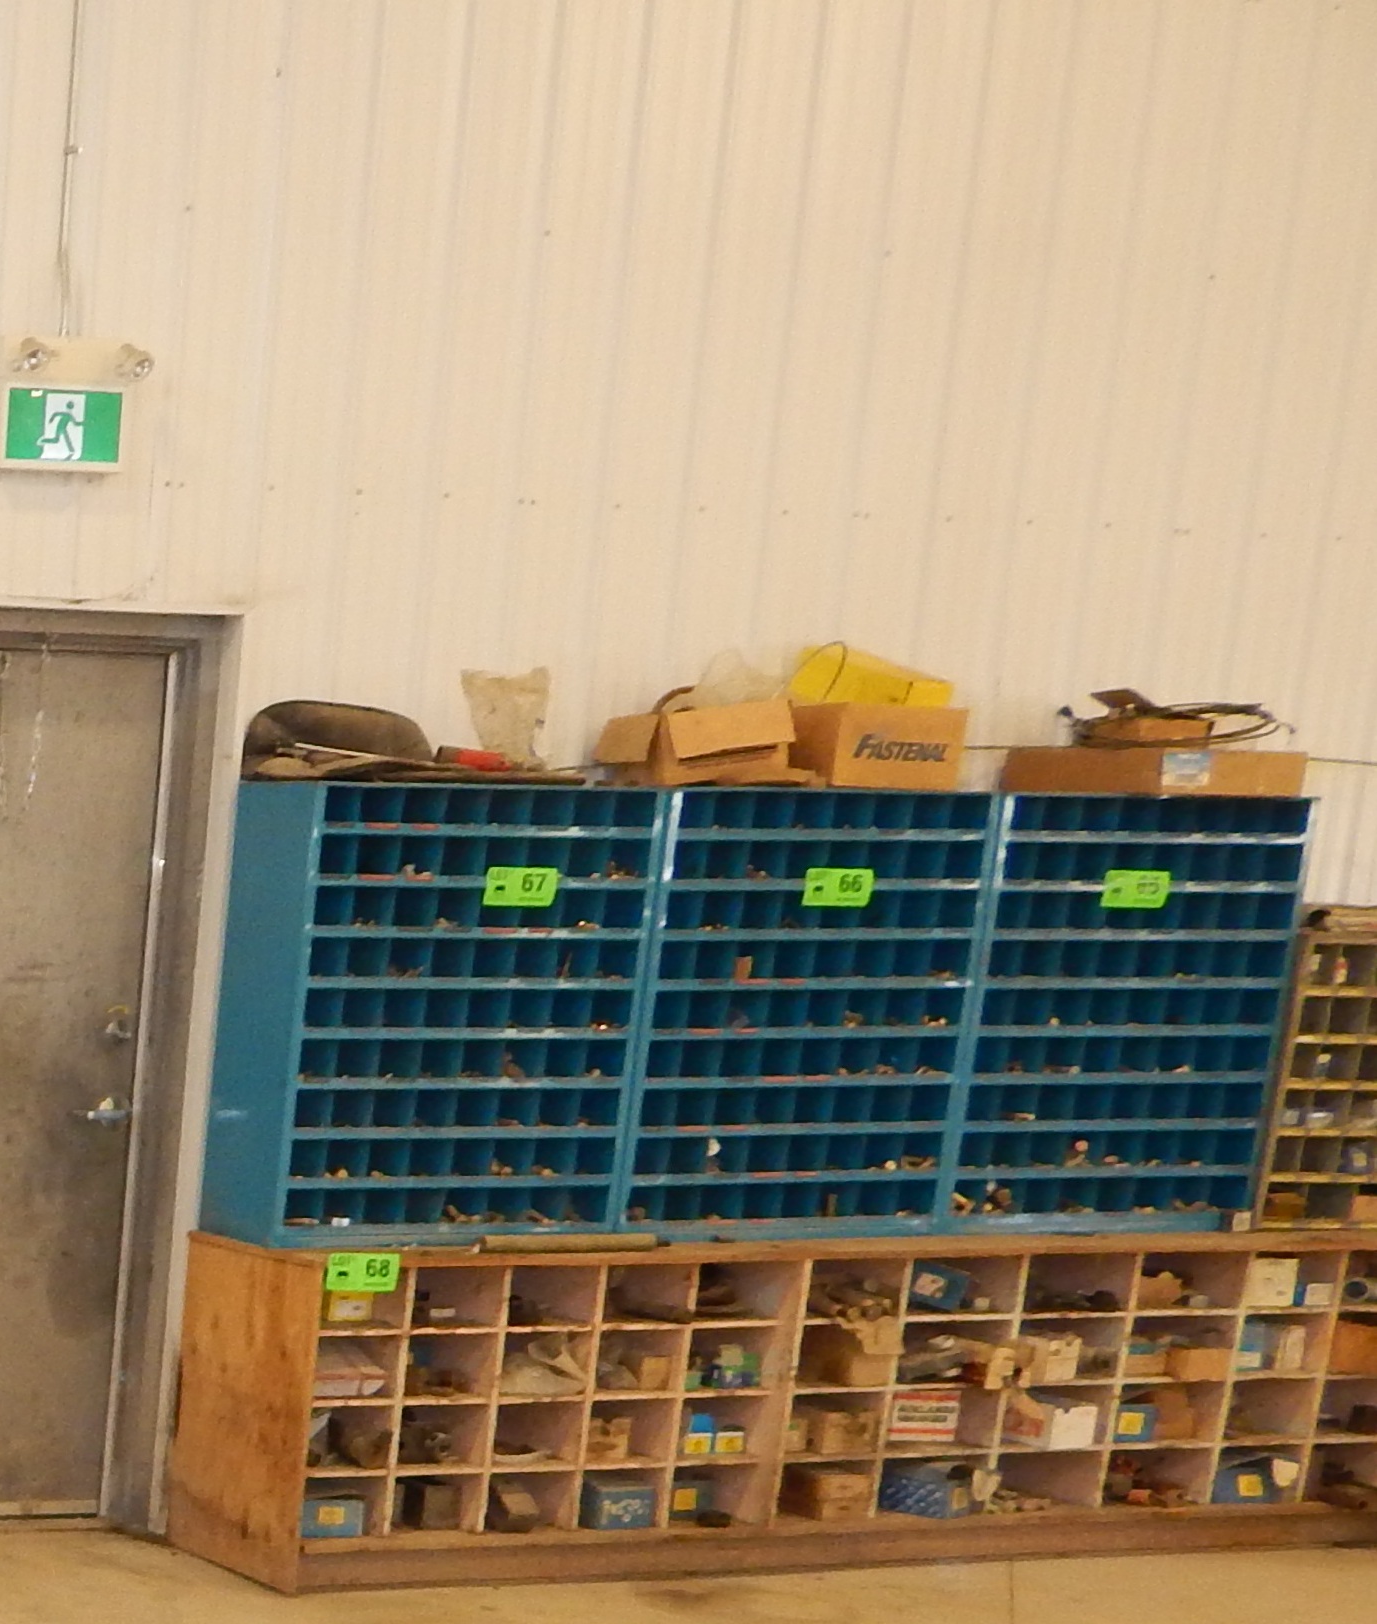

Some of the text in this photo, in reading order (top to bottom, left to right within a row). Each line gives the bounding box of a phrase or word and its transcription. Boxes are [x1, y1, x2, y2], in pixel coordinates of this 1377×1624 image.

[852, 732, 948, 762] FASTENAL
[521, 872, 548, 893] 67
[838, 873, 863, 893] 66
[366, 1258, 391, 1278] 68
